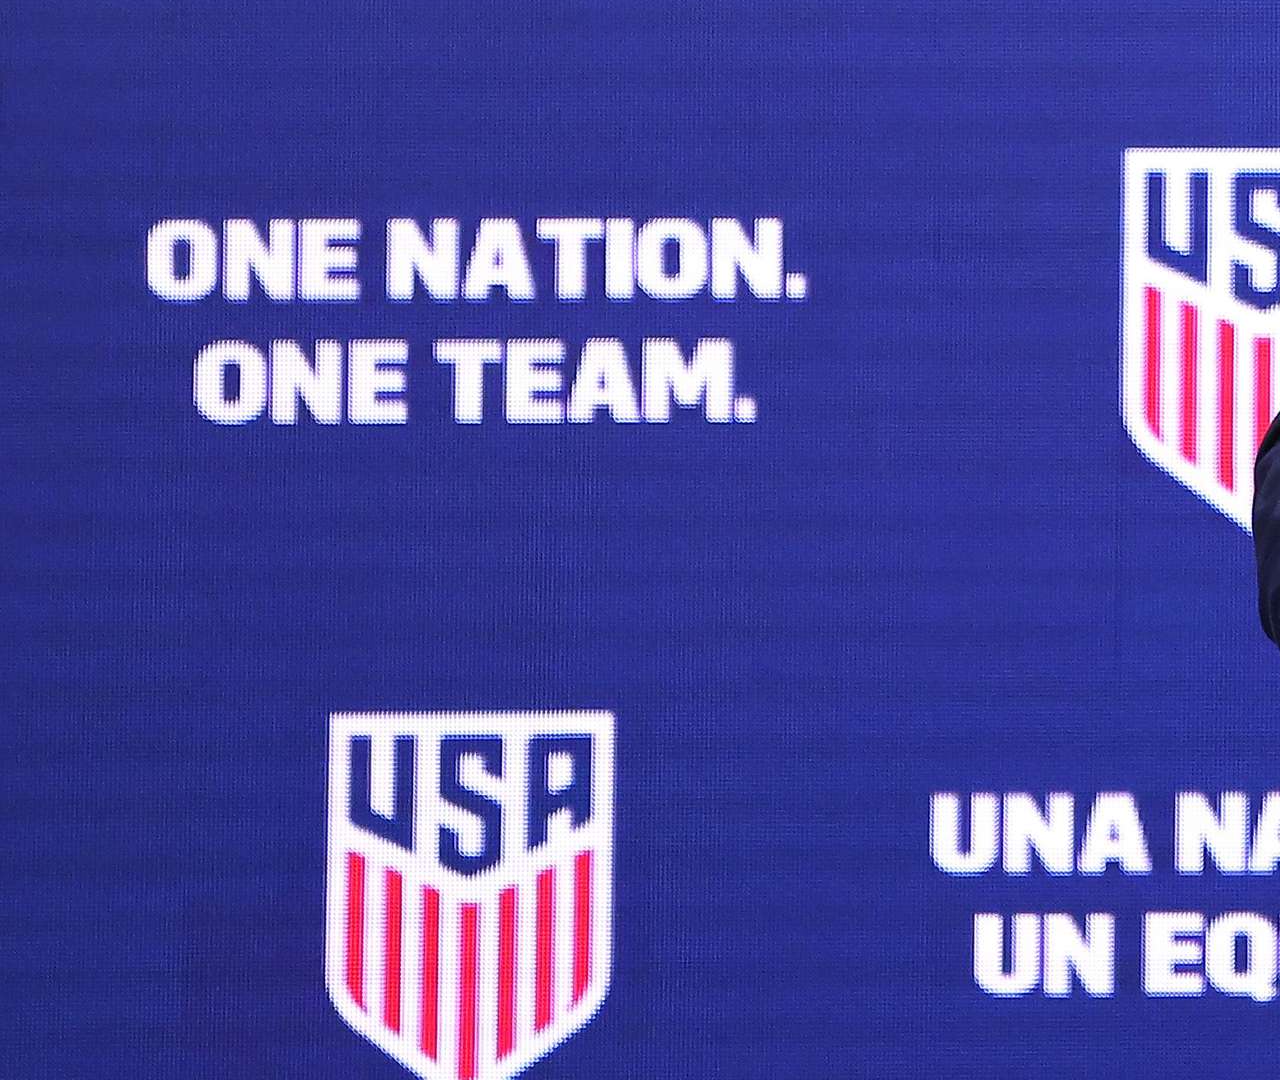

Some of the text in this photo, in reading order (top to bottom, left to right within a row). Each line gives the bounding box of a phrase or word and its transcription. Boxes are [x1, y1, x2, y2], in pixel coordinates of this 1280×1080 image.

[148, 218, 806, 301] ONE NATION.
[193, 338, 757, 425] ONE TEAM.
[349, 735, 595, 878] USA
[930, 792, 1153, 877] UNA
[974, 913, 1115, 998] UN
